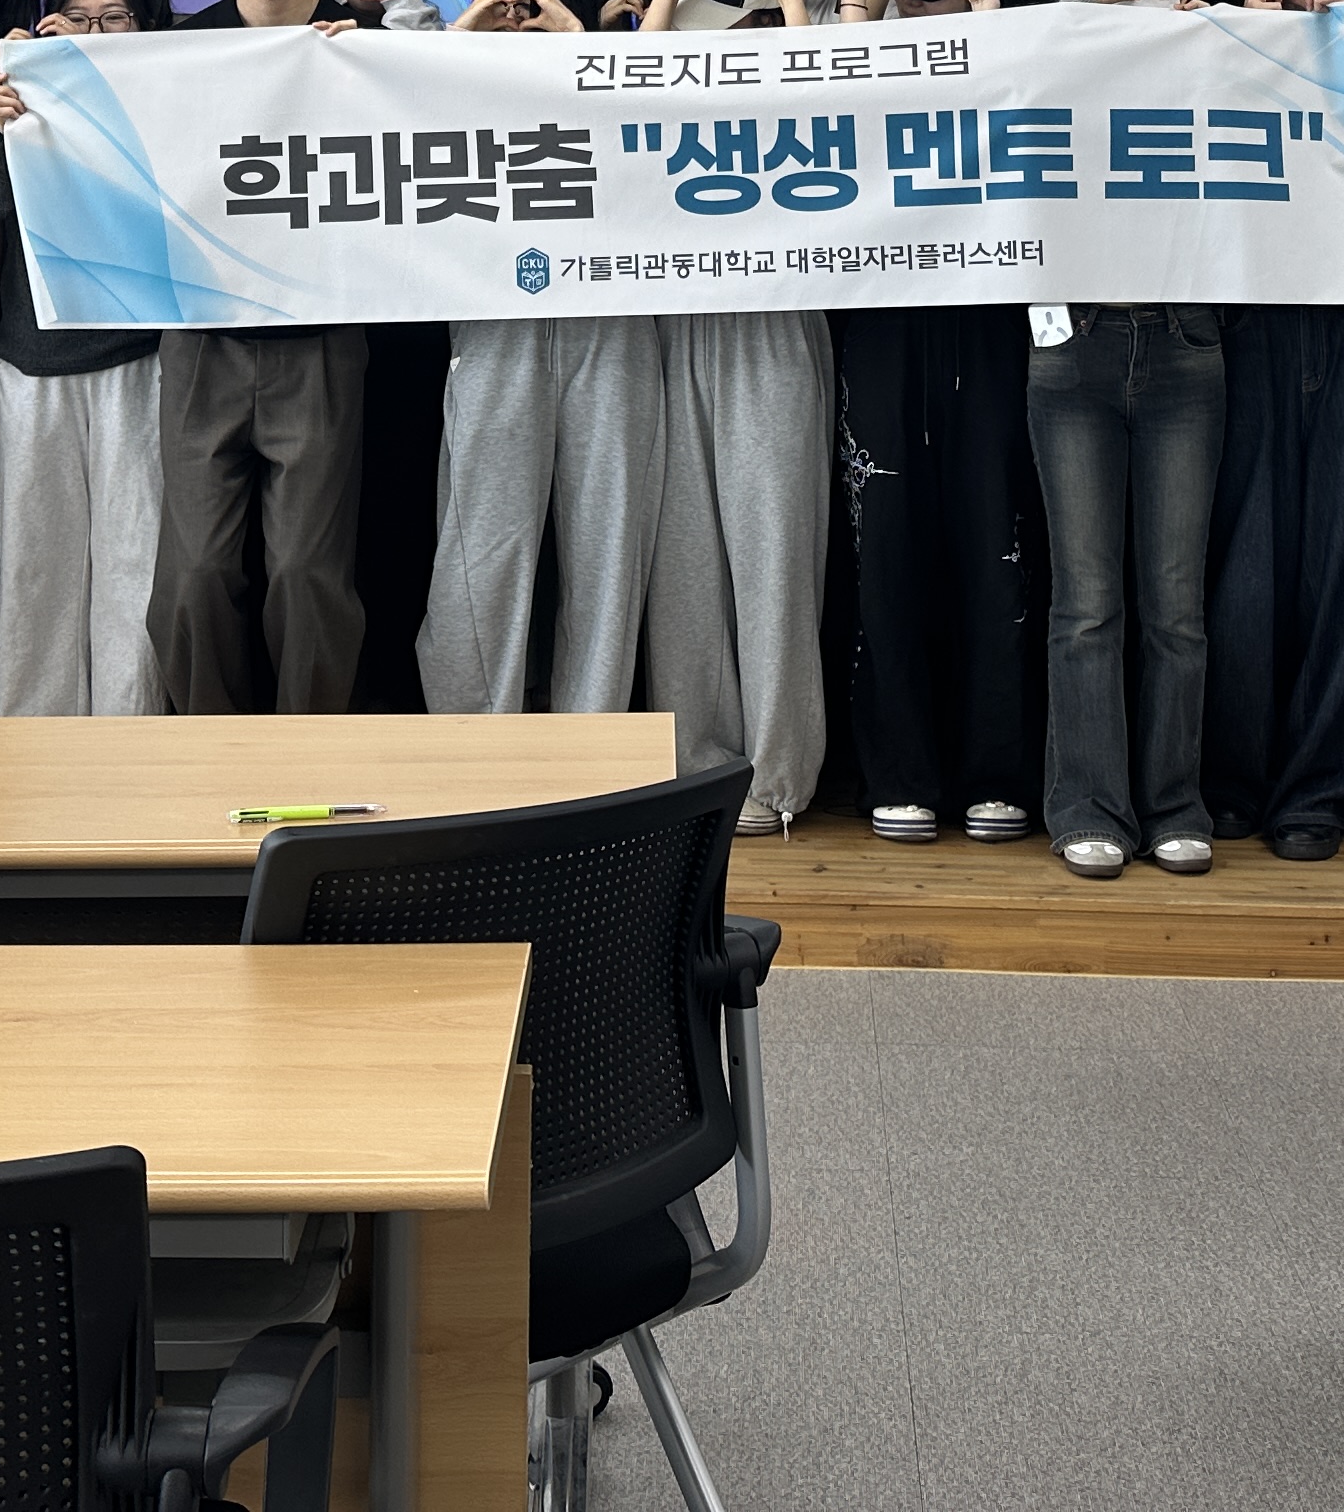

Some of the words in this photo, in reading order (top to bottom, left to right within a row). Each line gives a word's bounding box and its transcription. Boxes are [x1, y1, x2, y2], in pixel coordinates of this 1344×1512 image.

[575, 52, 762, 92] 진로지도
[780, 38, 970, 83] 프로그램
[219, 123, 598, 230] 학과맞춤
[620, 115, 859, 216] "생생
[885, 108, 1078, 208] 멘토
[1104, 108, 1324, 202] 토크"
[522, 258, 544, 269] CKU
[560, 248, 776, 281] 가톨릭관동대학교
[786, 239, 1045, 273] 대학일자리플러스센터
